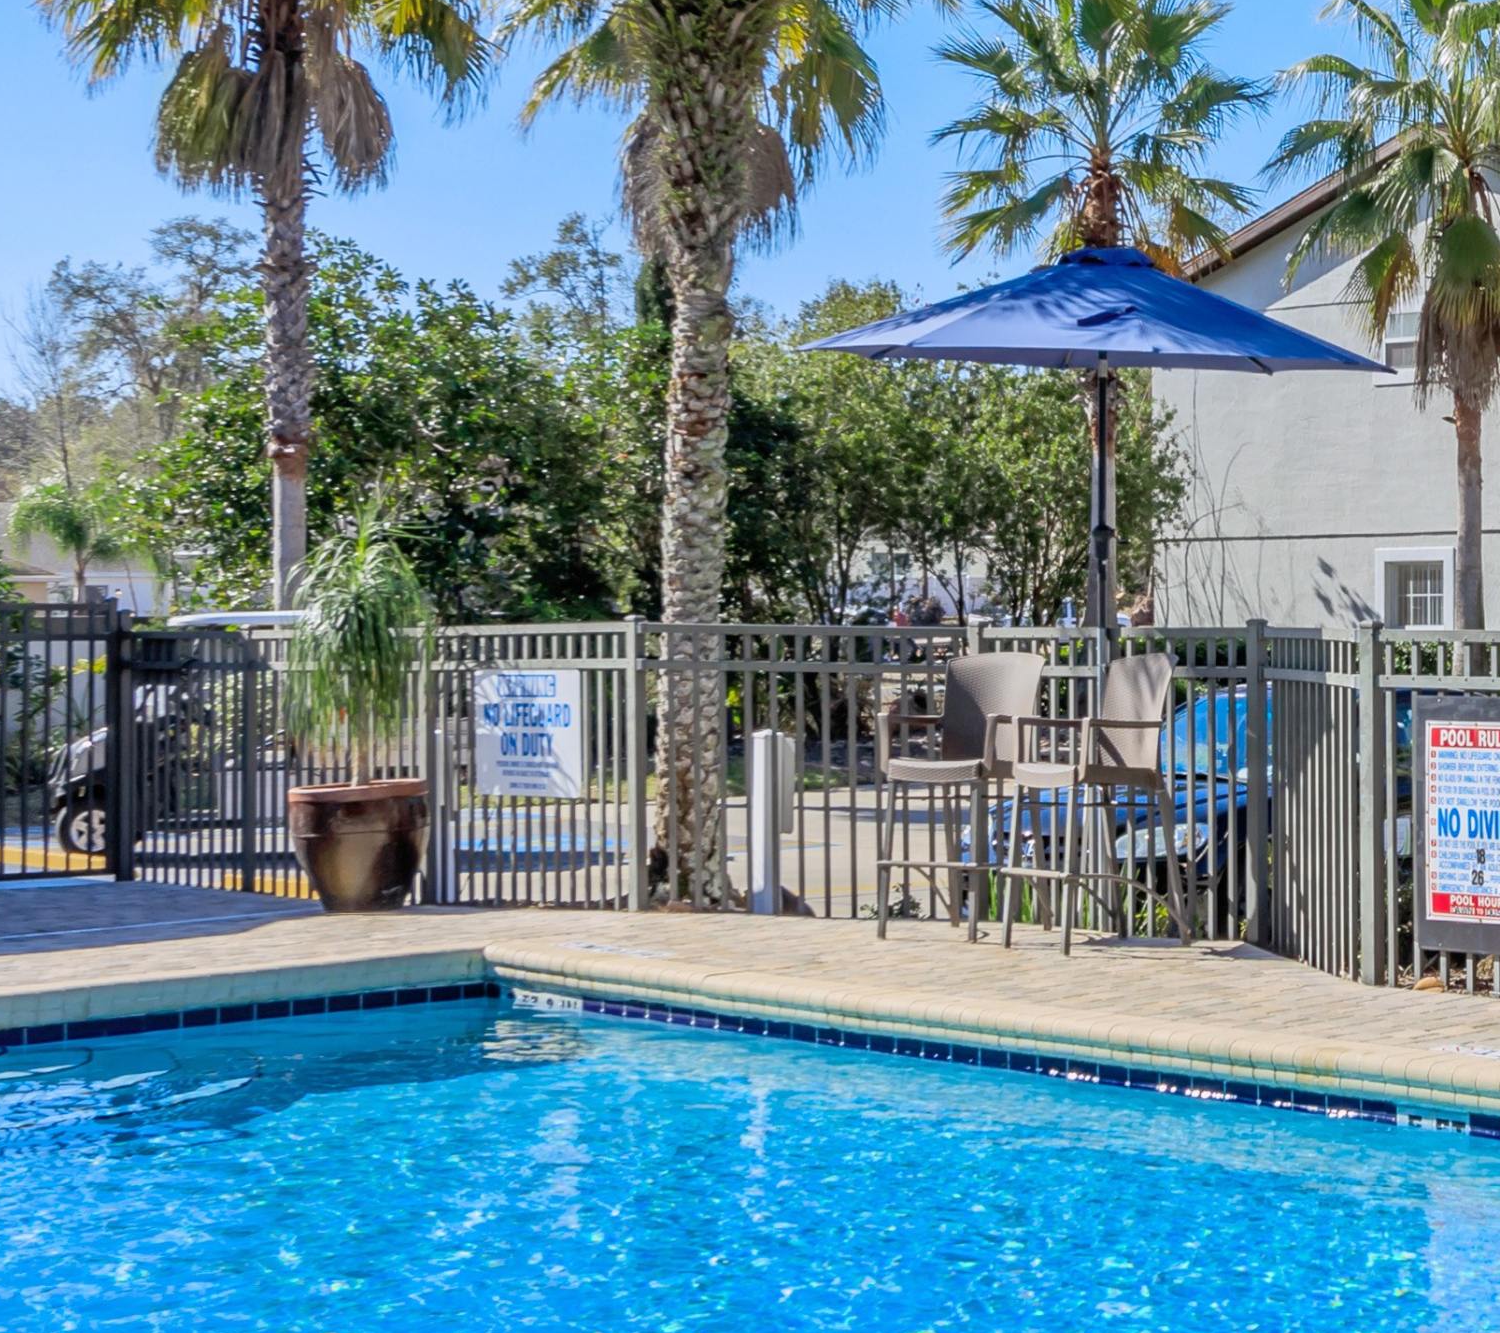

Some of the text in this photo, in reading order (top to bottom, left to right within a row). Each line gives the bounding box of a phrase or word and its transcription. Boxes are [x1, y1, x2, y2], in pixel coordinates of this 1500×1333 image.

[484, 703, 570, 727] NO LIFEGUARD
[501, 732, 553, 757] ON DUTY
[1440, 730, 1474, 746] POOL
[1438, 808, 1460, 838] NO
[1476, 849, 1485, 864] 18
[1471, 870, 1484, 886] 26
[1450, 894, 1474, 906] POOL
